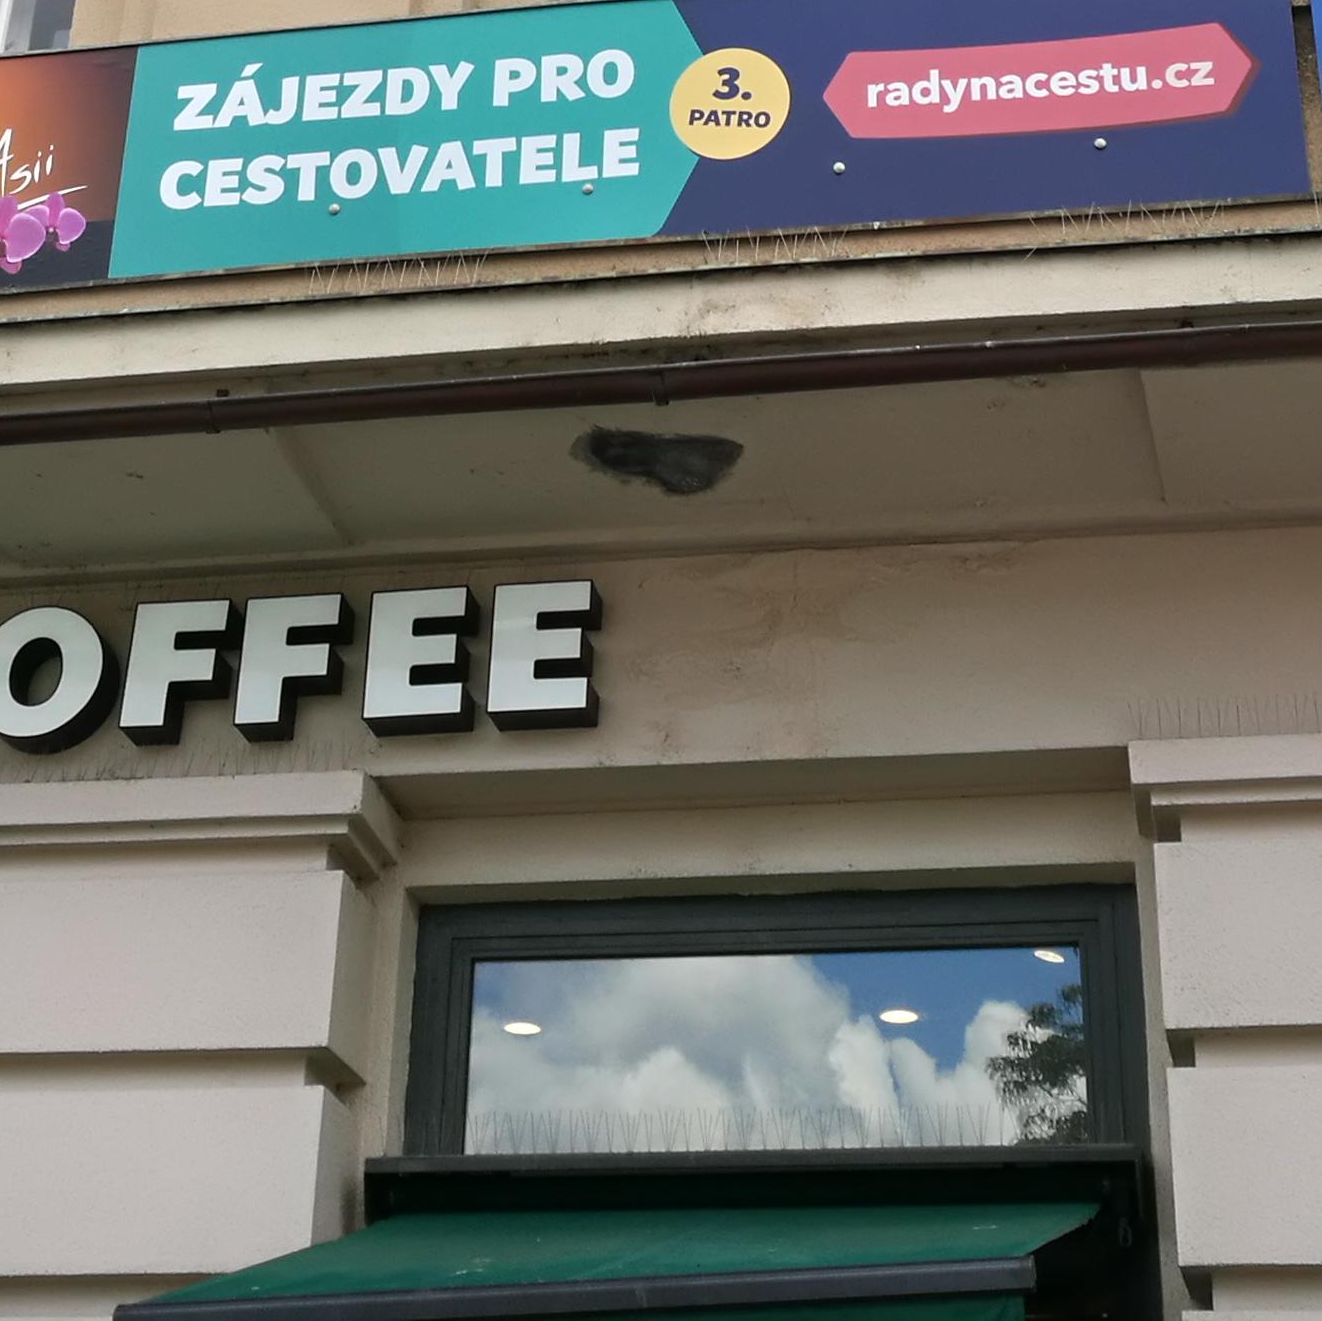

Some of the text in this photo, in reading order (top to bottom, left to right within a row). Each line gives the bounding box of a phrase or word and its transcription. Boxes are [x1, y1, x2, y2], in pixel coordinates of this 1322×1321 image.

[173, 48, 635, 131] ZÁJEZDY PRO
[712, 67, 752, 101] 3.
[866, 61, 1214, 113] radynacestu.cz
[687, 108, 771, 129] PATRO
[159, 127, 640, 210] CESTOVATELE
